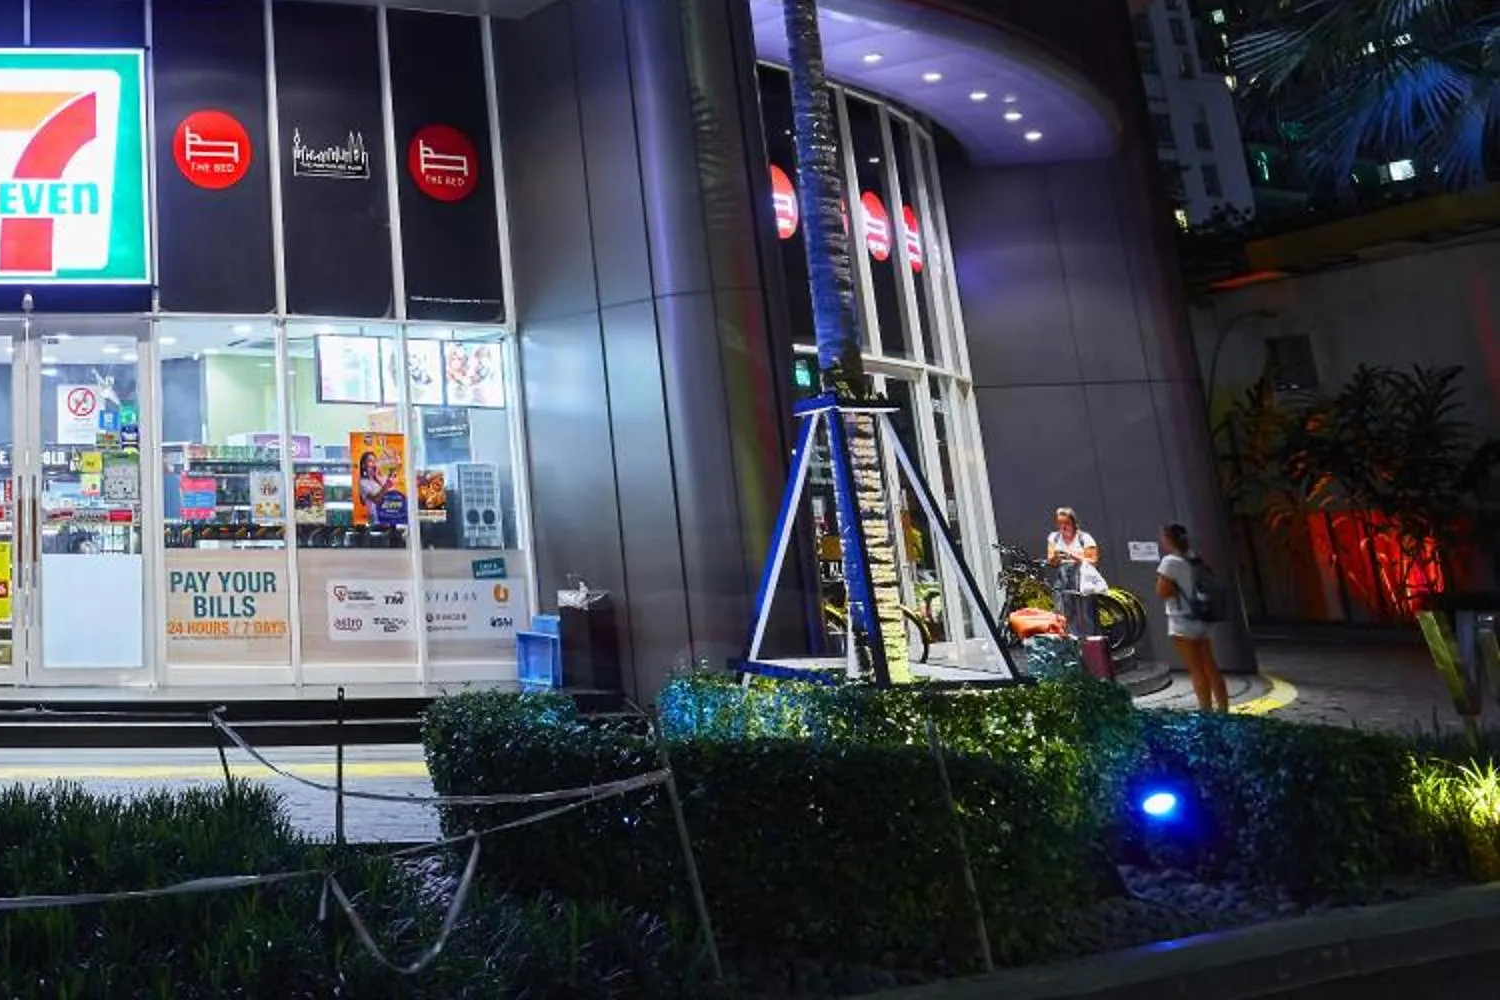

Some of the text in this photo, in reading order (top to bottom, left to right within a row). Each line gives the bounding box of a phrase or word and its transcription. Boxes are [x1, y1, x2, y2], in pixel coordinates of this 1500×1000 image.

[190, 162, 235, 173] THE BED
[43, 451, 69, 465] OLD.
[170, 571, 277, 593] PAY YOUR
[193, 595, 257, 618] BILLS
[167, 621, 183, 635] 24
[186, 621, 230, 635] HOURS
[253, 621, 287, 634] DAYS
